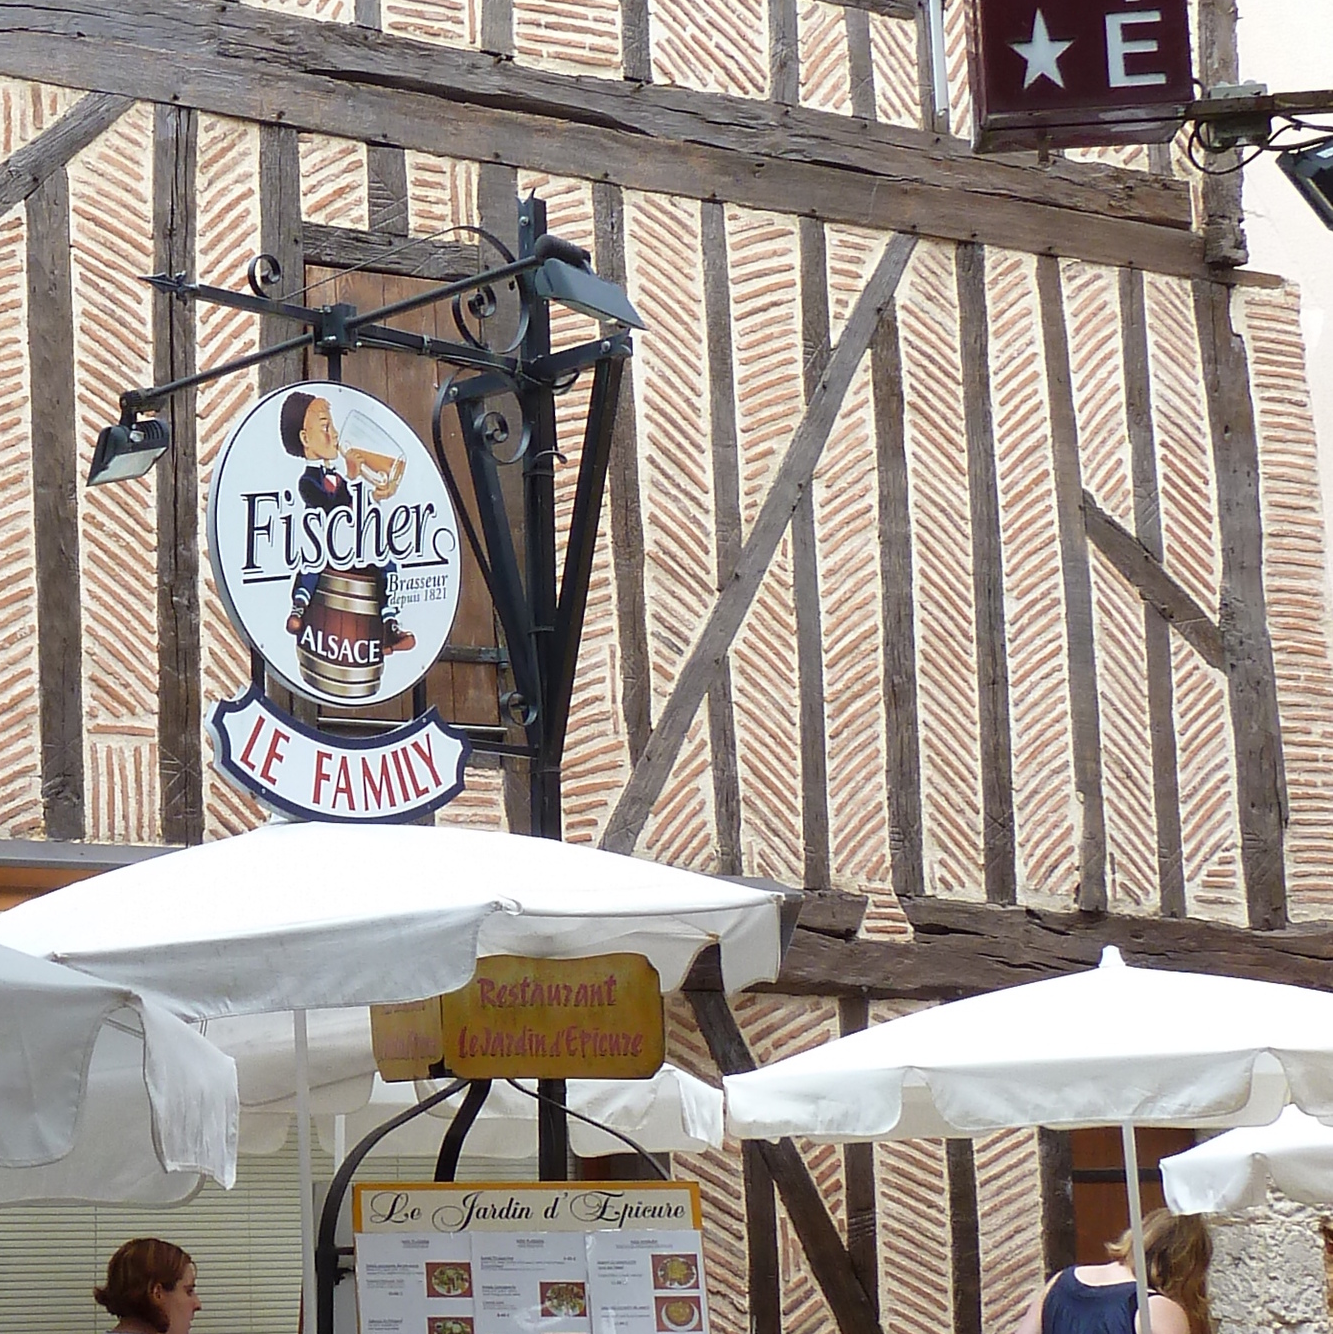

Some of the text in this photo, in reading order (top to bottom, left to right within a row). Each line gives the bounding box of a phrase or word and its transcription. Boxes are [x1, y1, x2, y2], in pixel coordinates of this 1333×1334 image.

[239, 482, 438, 573] Fischer
[389, 574, 448, 592] Brasseur
[390, 587, 446, 608] depuis 1821
[301, 629, 381, 664] ALSACE
[239, 715, 443, 812] LE FAMILY
[477, 975, 617, 1008] Restaurant
[370, 1192, 422, 1224] Le
[432, 1191, 533, 1232] Jardin
